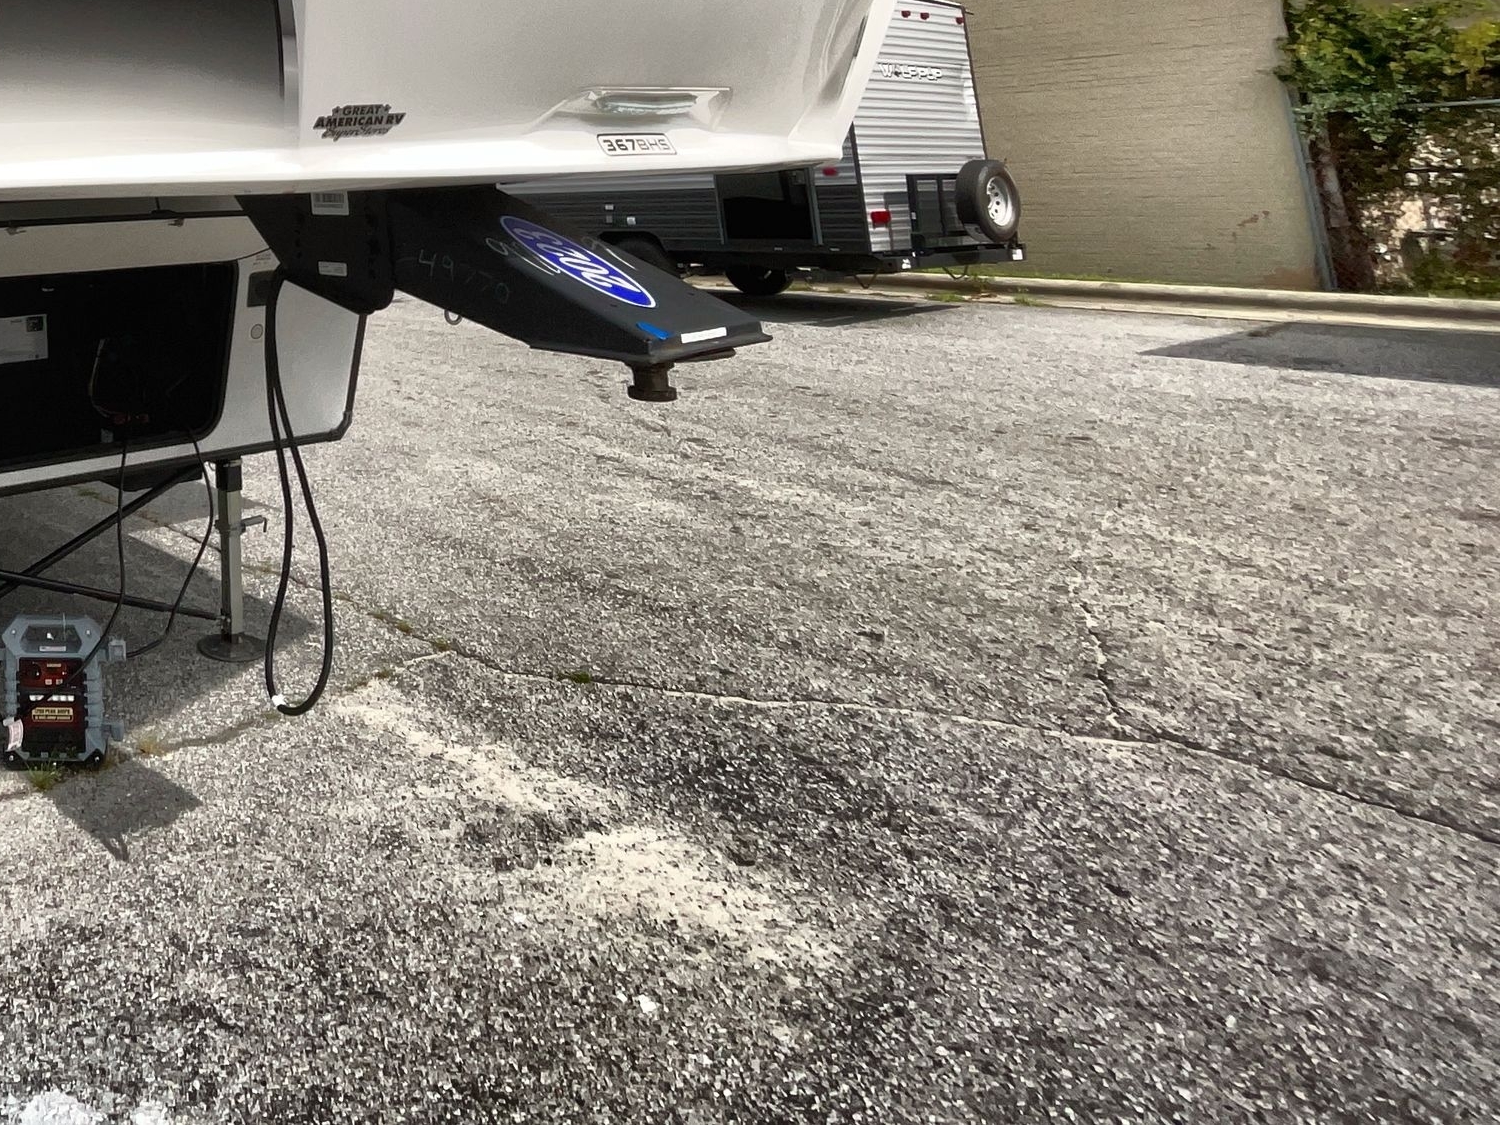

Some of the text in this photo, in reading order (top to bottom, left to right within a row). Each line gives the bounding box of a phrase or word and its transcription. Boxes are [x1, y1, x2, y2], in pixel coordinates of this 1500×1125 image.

[342, 105, 382, 116] GREAT
[313, 113, 406, 130] AMERICAN RV
[603, 139, 670, 152] 367BHS
[513, 226, 642, 294] 2023
